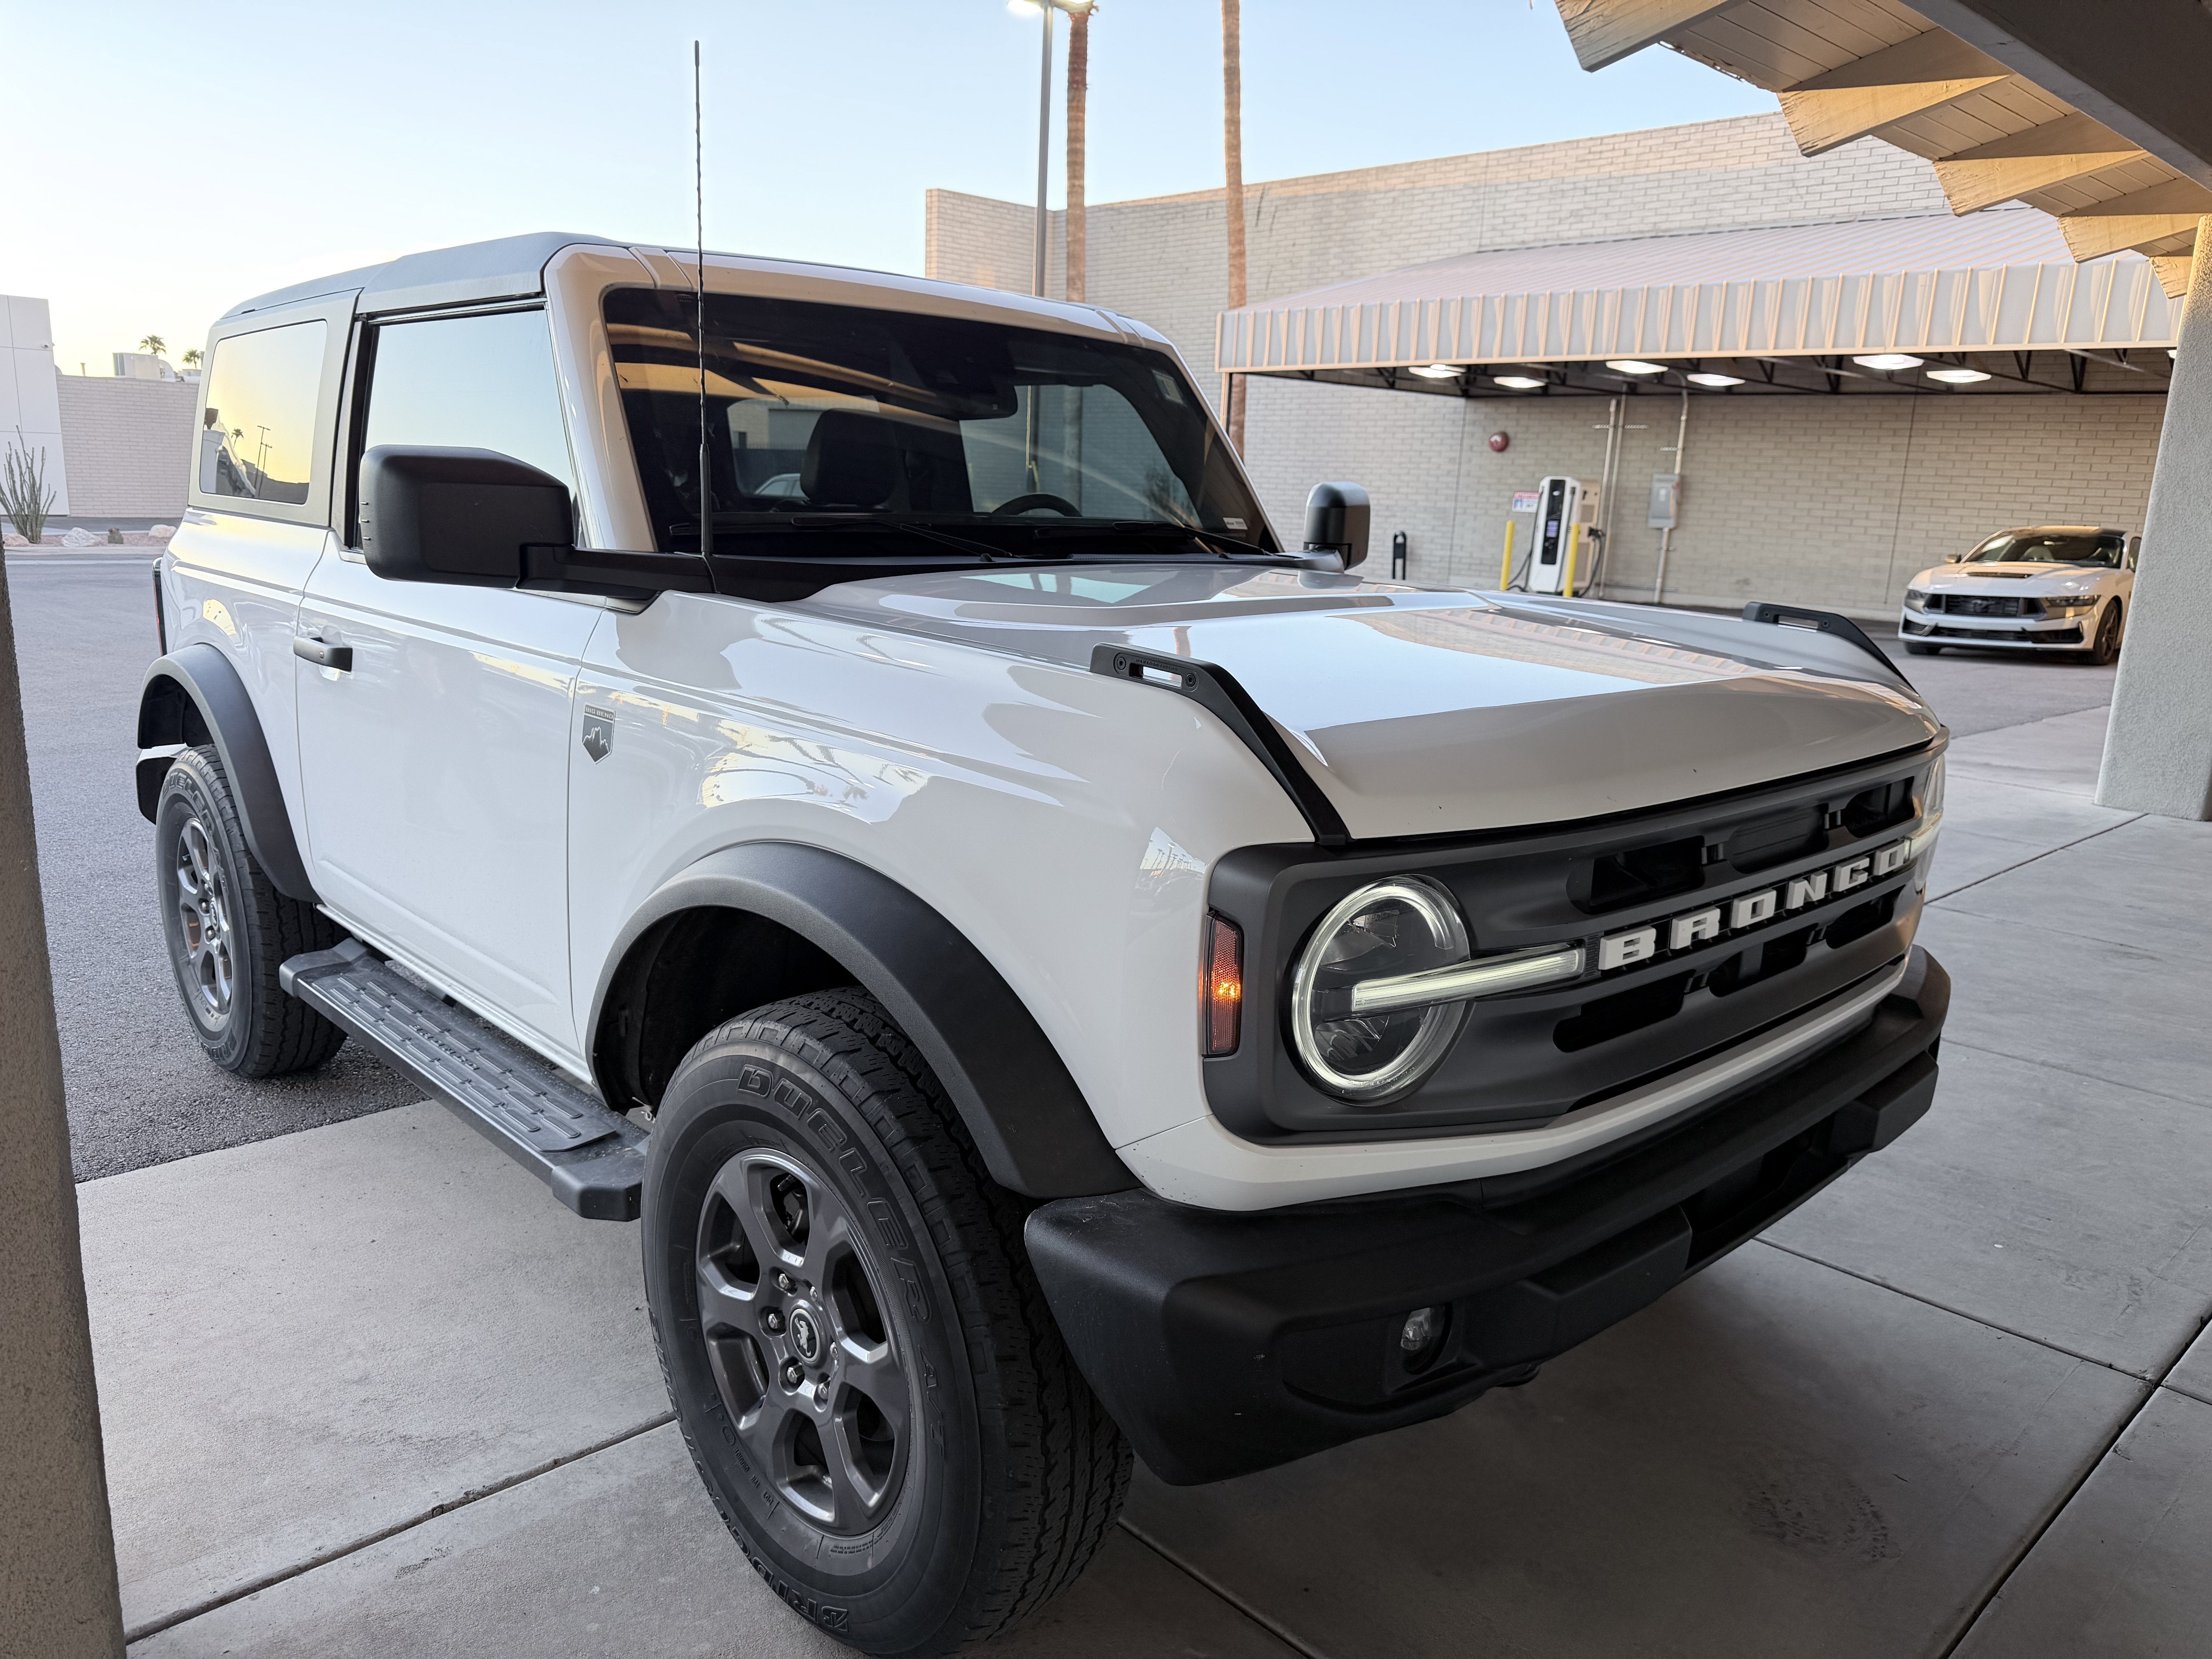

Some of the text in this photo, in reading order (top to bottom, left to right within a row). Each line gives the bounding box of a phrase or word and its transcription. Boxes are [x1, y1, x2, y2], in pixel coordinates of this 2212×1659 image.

[597, 711, 613, 719] BEND
[1598, 840, 1905, 970] BRONCO
[409, 1024, 480, 1070] BRONCO
[737, 1064, 931, 1321] DUELER
